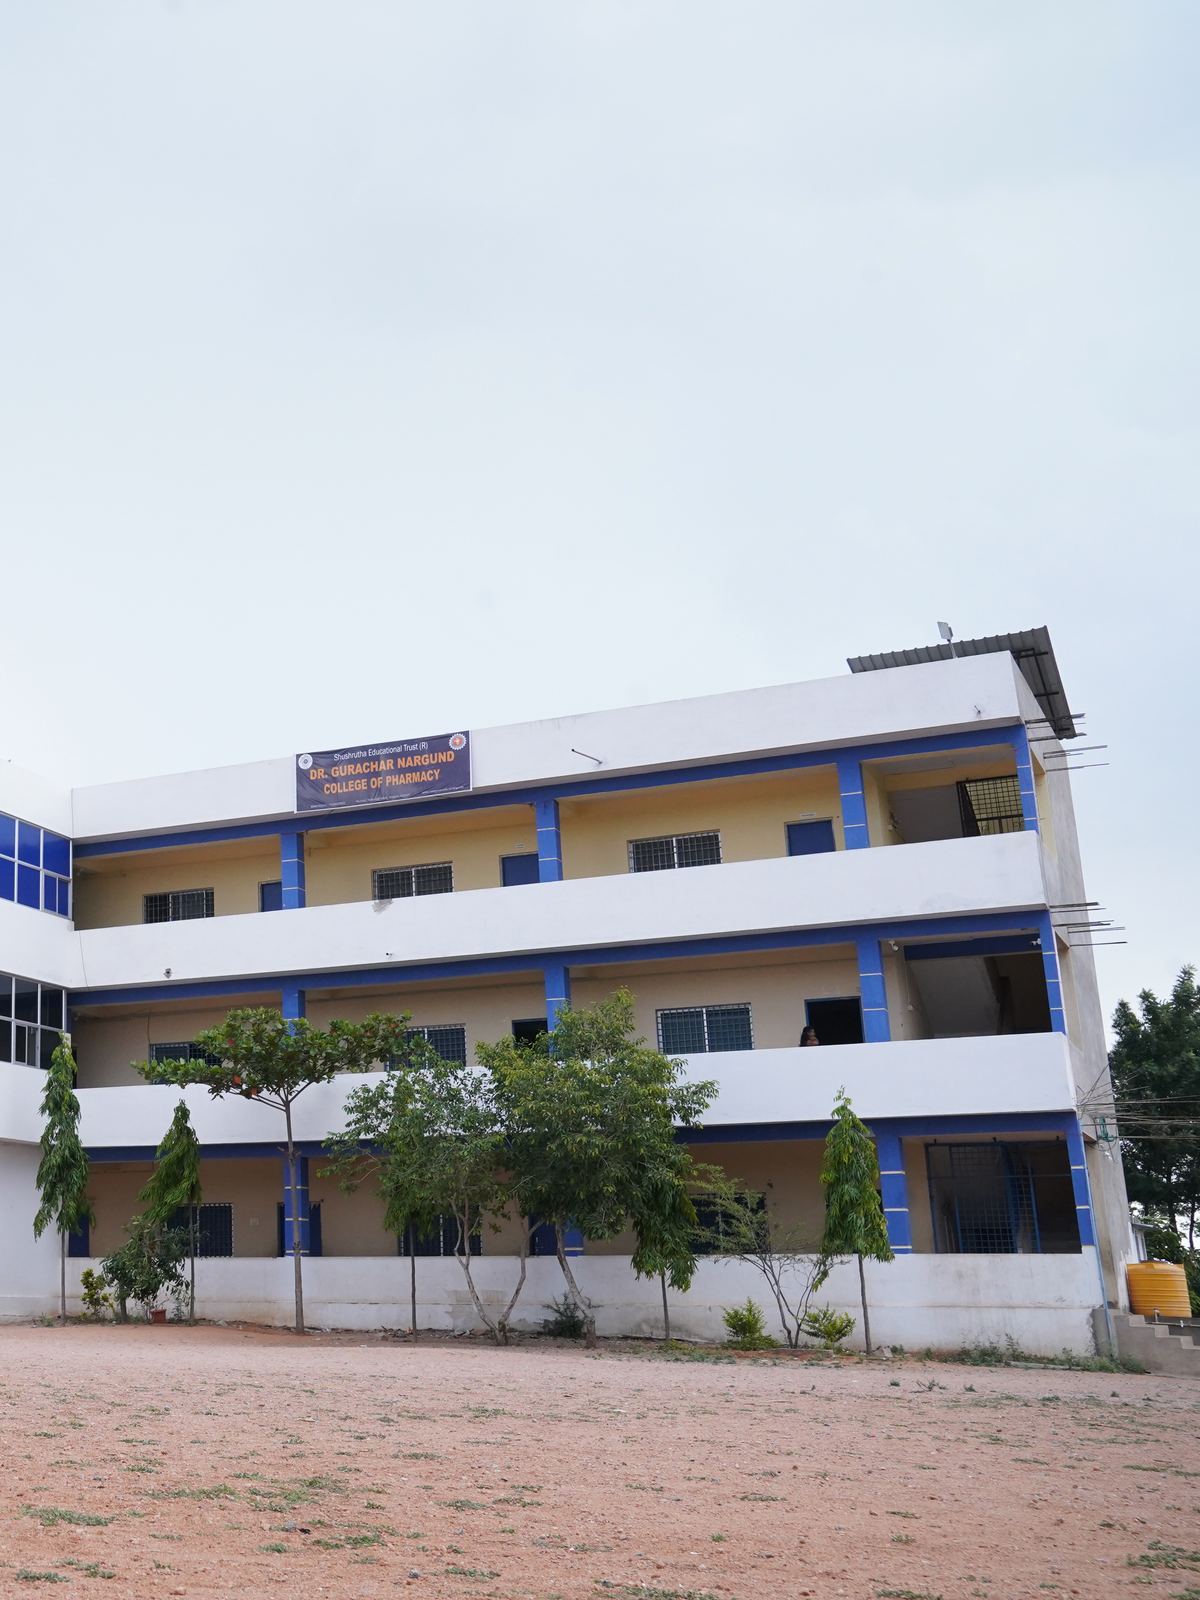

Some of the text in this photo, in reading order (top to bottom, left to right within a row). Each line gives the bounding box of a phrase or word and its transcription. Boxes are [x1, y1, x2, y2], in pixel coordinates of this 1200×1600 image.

[334, 741, 428, 762] Shushrutha Educational Trust (R)
[310, 750, 455, 780] DR. GURACHAR NARGUND
[323, 768, 440, 794] COLLEGE OF PHARMACY
